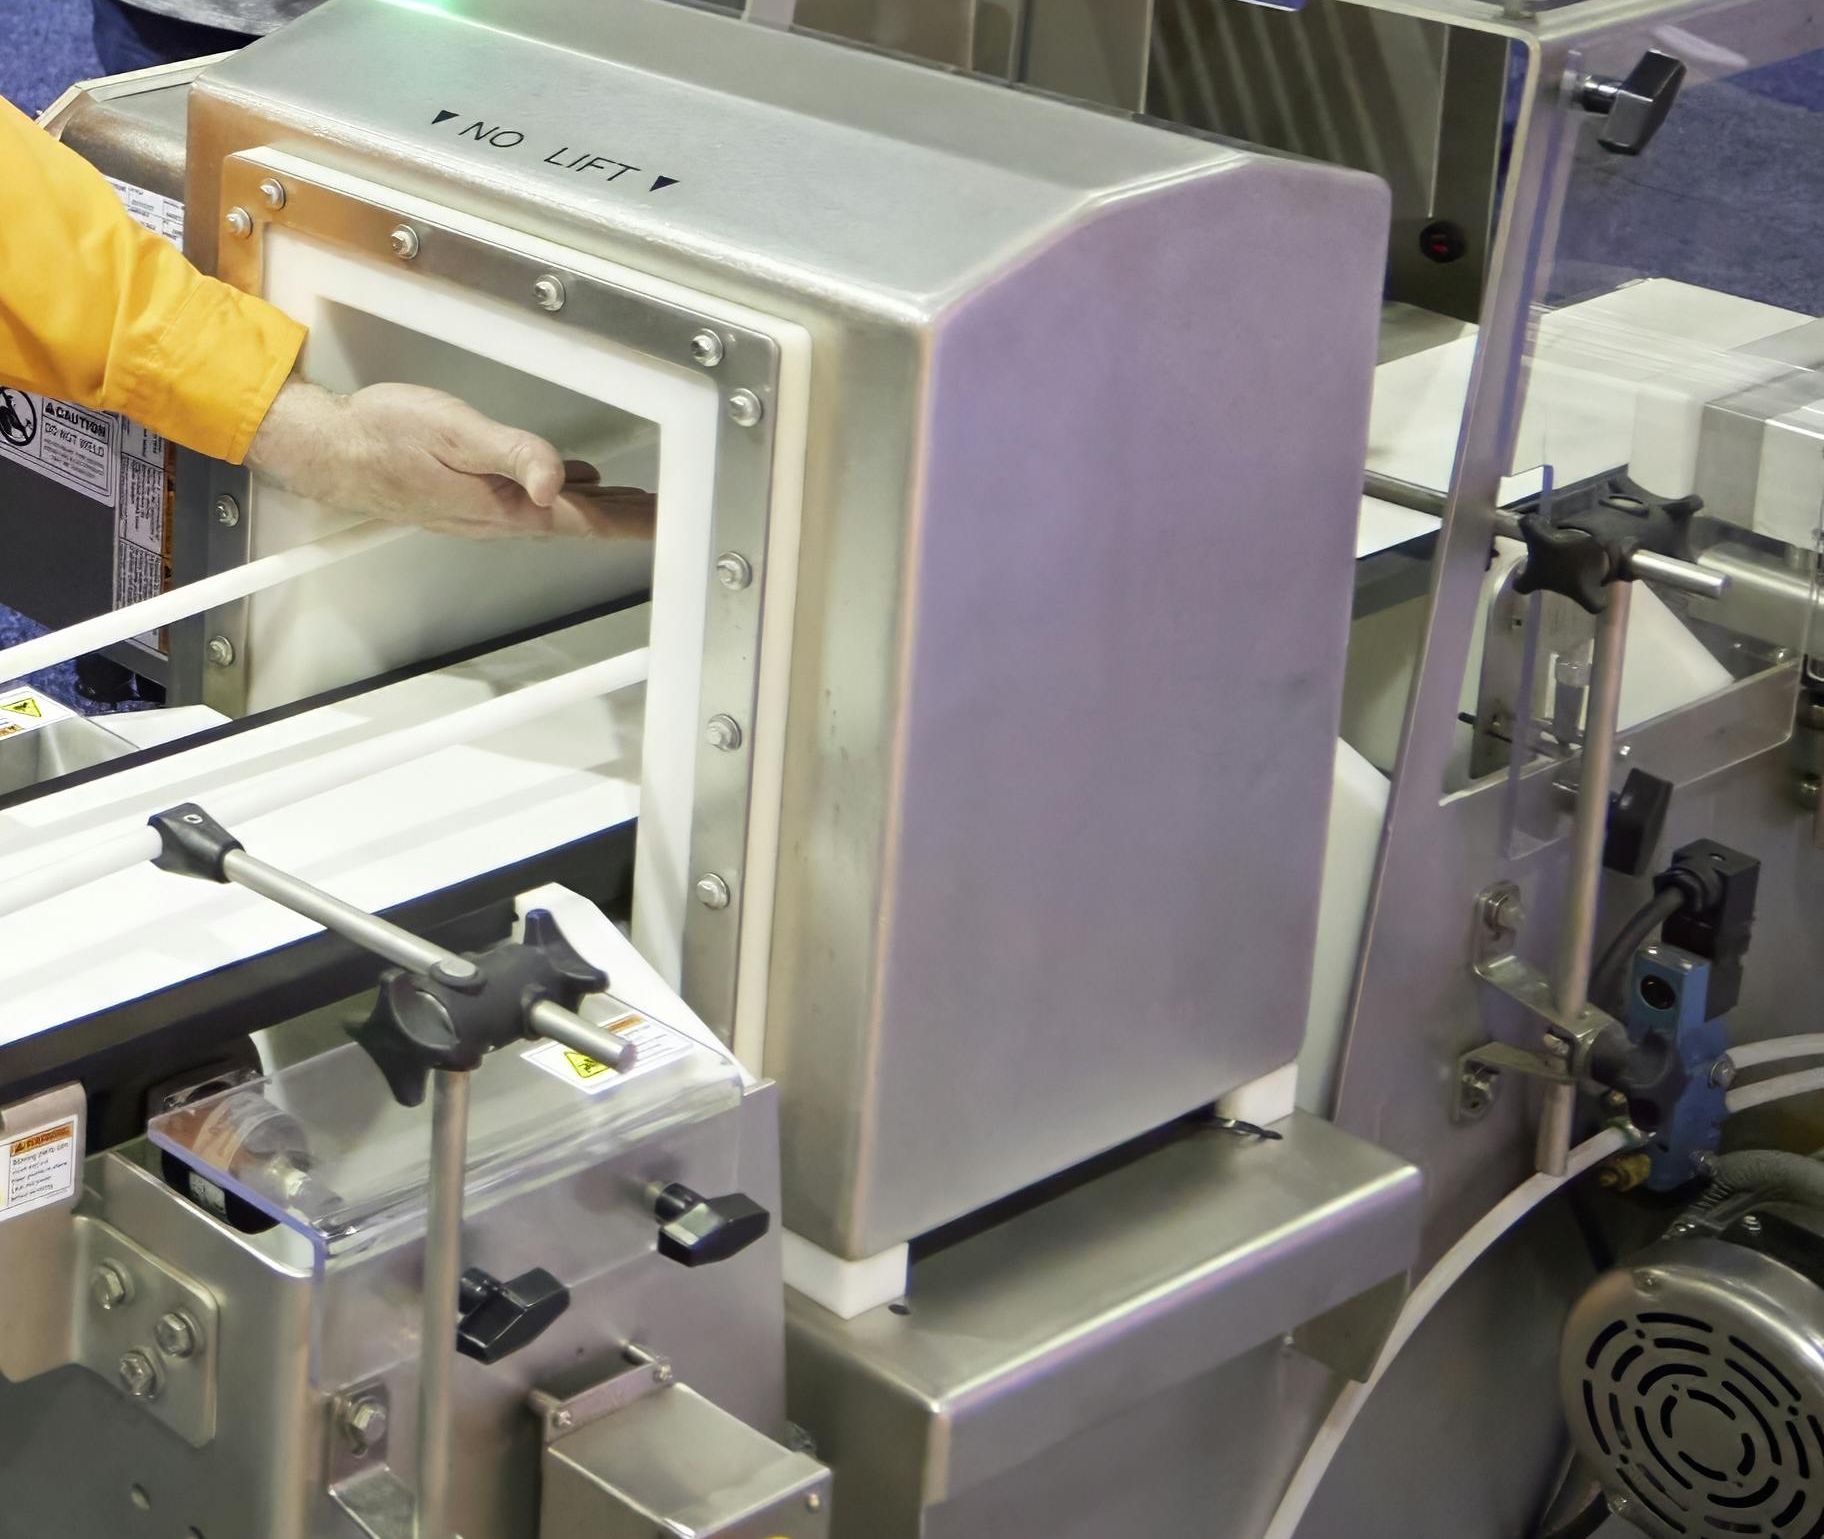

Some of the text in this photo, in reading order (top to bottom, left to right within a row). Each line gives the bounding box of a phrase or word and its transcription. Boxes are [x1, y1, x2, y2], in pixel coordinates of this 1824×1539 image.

[457, 119, 642, 183] NO LIFT
[55, 406, 108, 439] CAUTION
